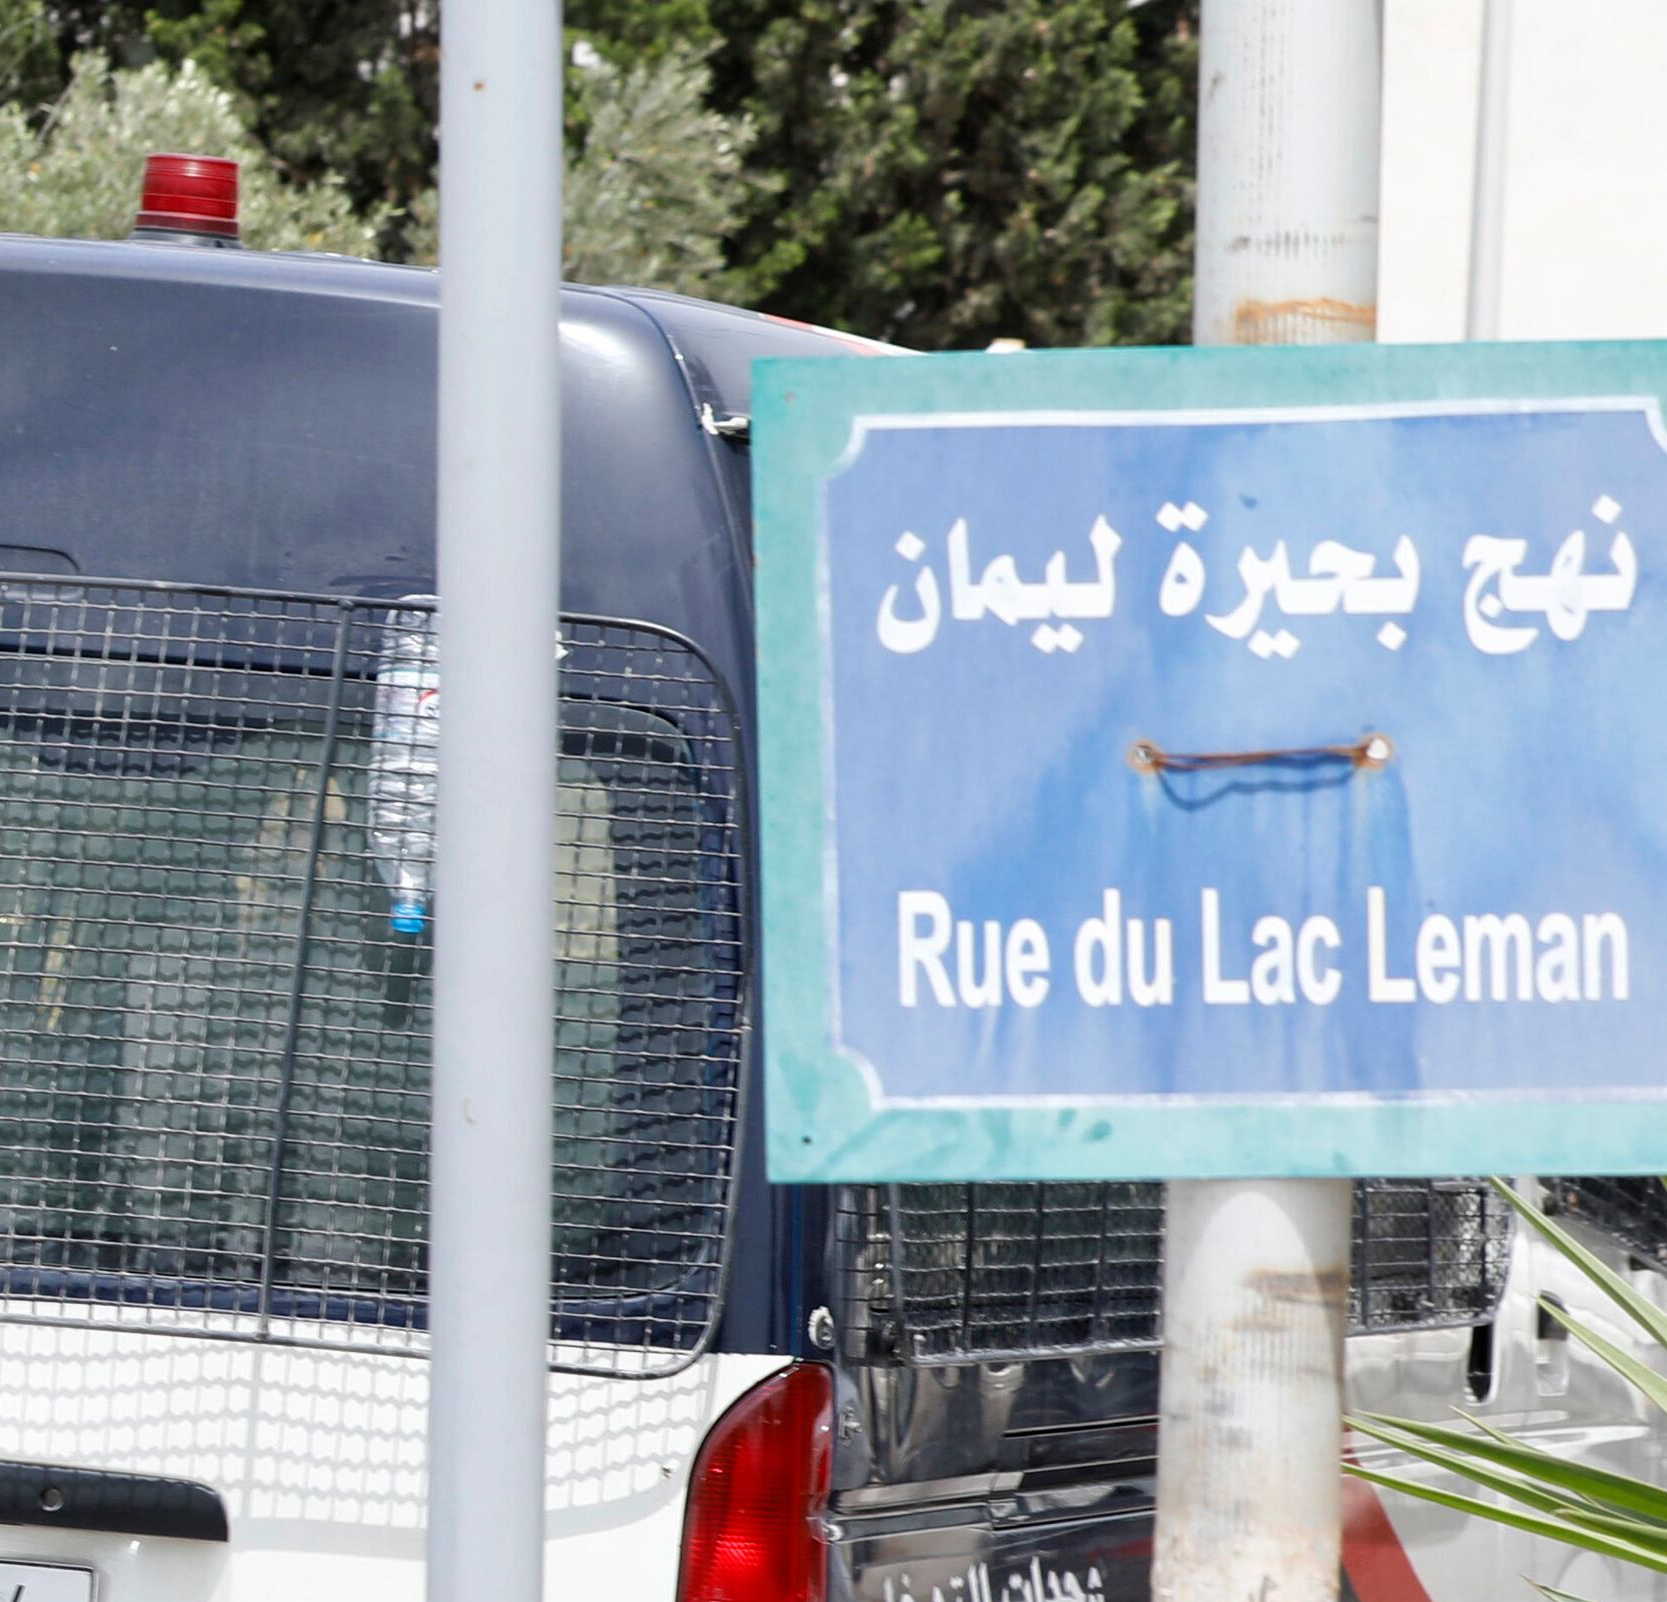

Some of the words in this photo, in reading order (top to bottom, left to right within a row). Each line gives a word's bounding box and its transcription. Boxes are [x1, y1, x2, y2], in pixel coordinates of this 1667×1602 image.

[876, 513, 1123, 655] ليمان
[1155, 501, 1421, 660] بحيرة
[1463, 494, 1639, 655] نهج
[898, 890, 1051, 1008] Rue
[1074, 887, 1172, 1005] du
[1202, 886, 1343, 1003] Lac
[1366, 885, 1630, 1002] Leman
